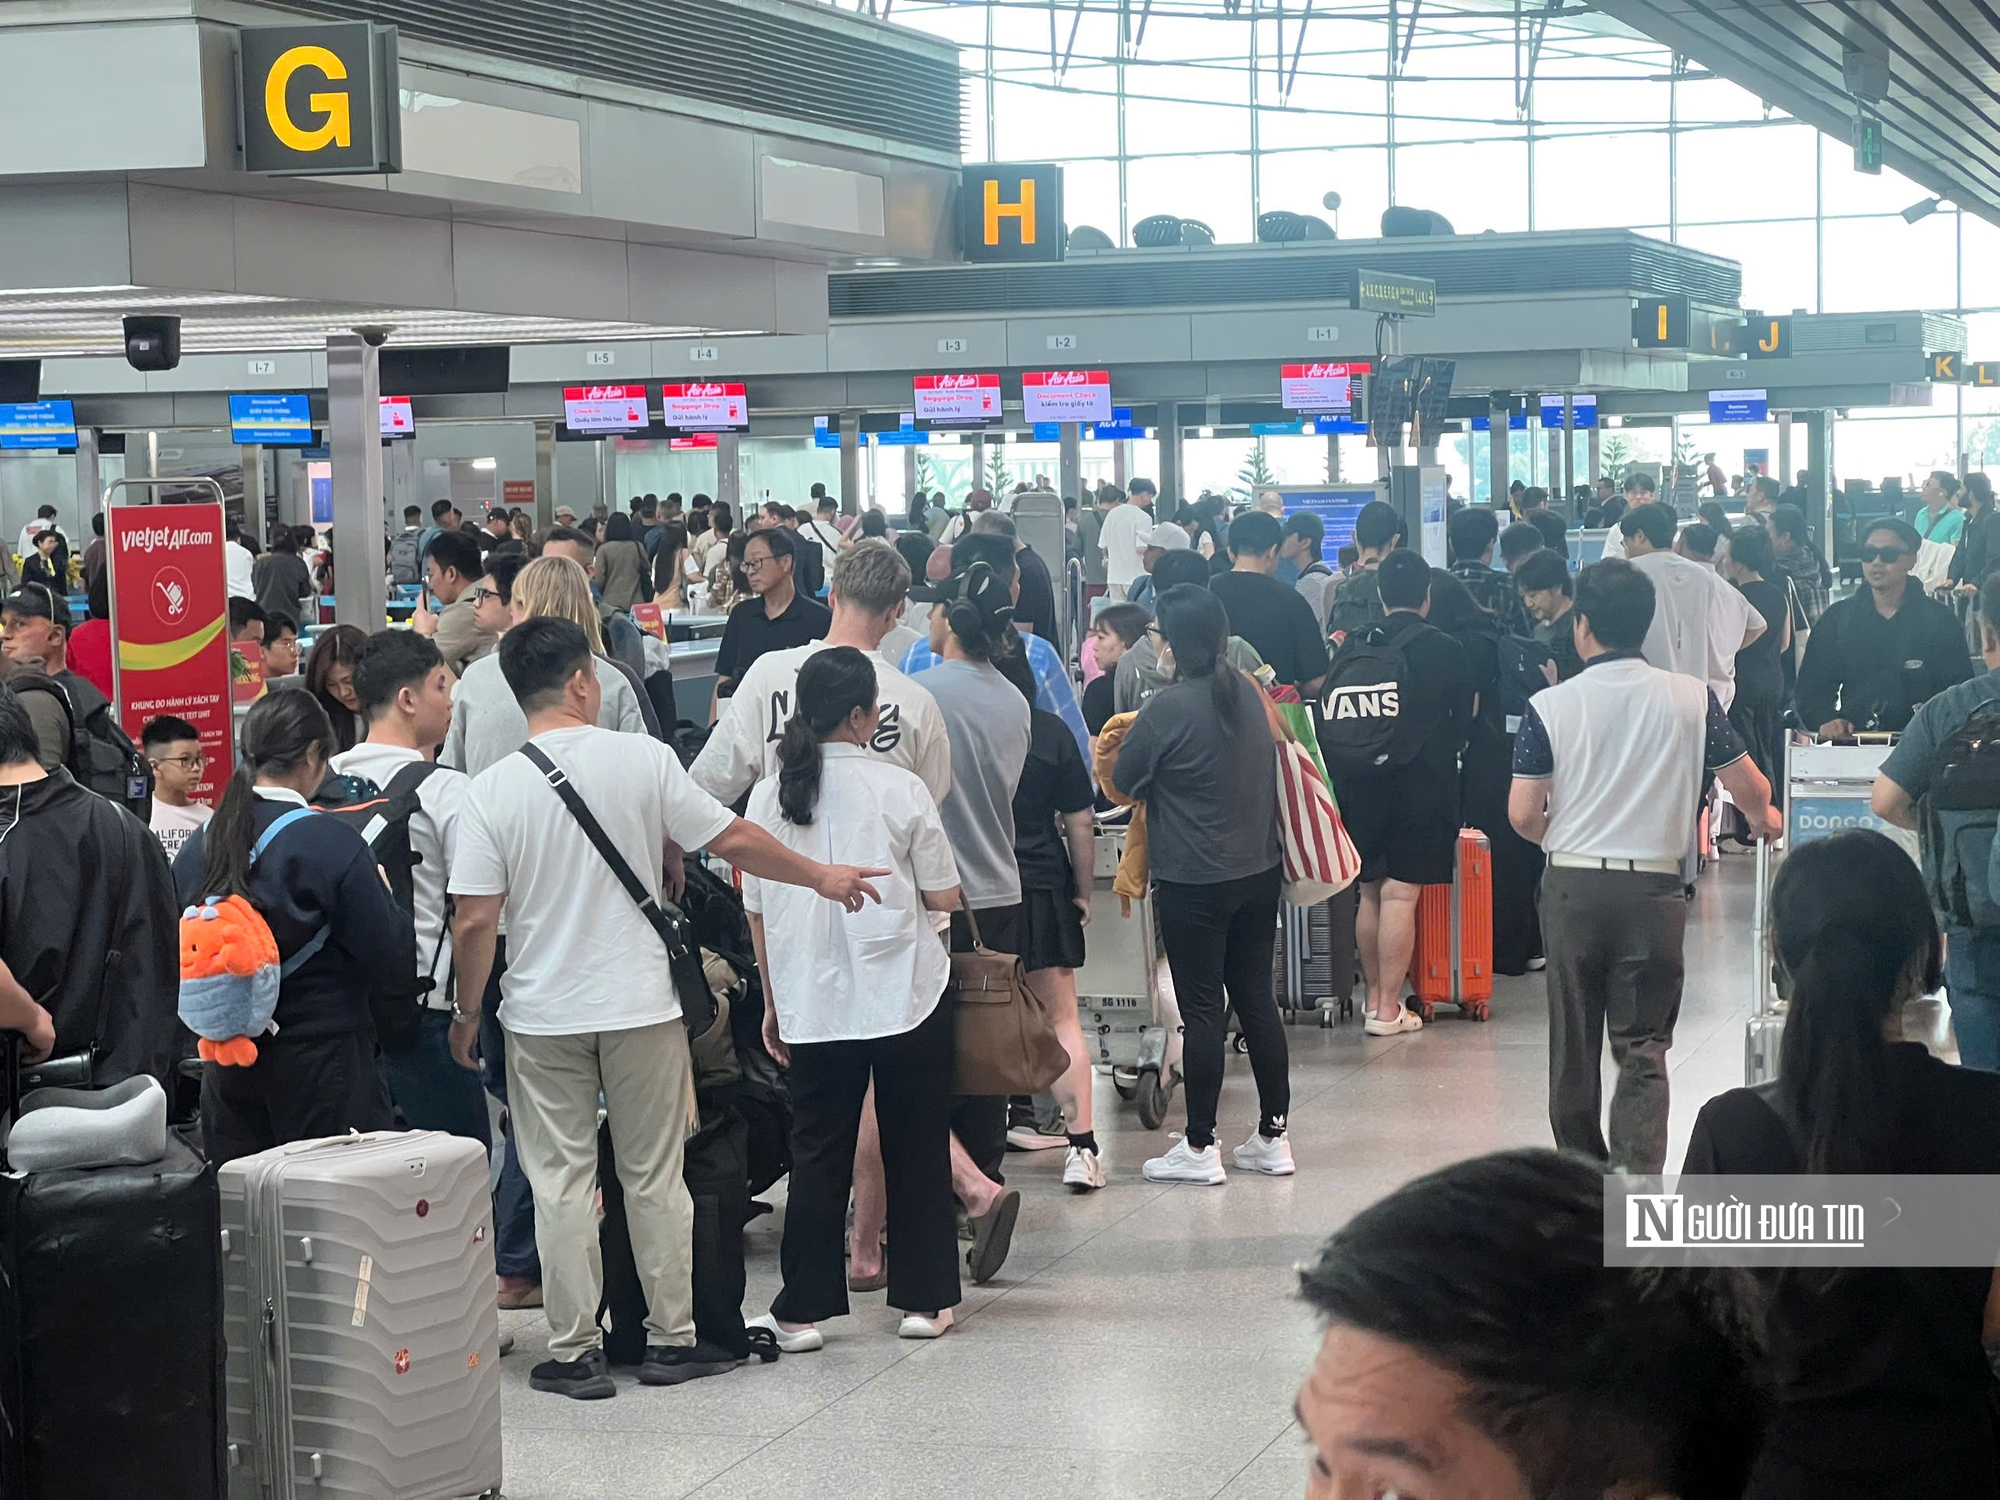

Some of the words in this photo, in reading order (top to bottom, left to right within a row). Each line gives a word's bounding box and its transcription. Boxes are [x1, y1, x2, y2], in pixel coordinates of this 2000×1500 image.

[265, 45, 351, 152] G
[983, 179, 1036, 245] H
[1658, 305, 1667, 340] I
[1316, 328, 1331, 340] I-1
[1758, 321, 1779, 353] J
[945, 340, 961, 351] I-3
[1055, 336, 1071, 348] I-2
[594, 352, 609, 363] I-5
[697, 348, 712, 359] I-4
[255, 362, 270, 373] I-7
[1935, 356, 1953, 378] K
[1978, 364, 1994, 384] L
[130, 701, 155, 711] KHUNG
[1321, 681, 1400, 721] VANS
[156, 828, 193, 839] ALIFOR
